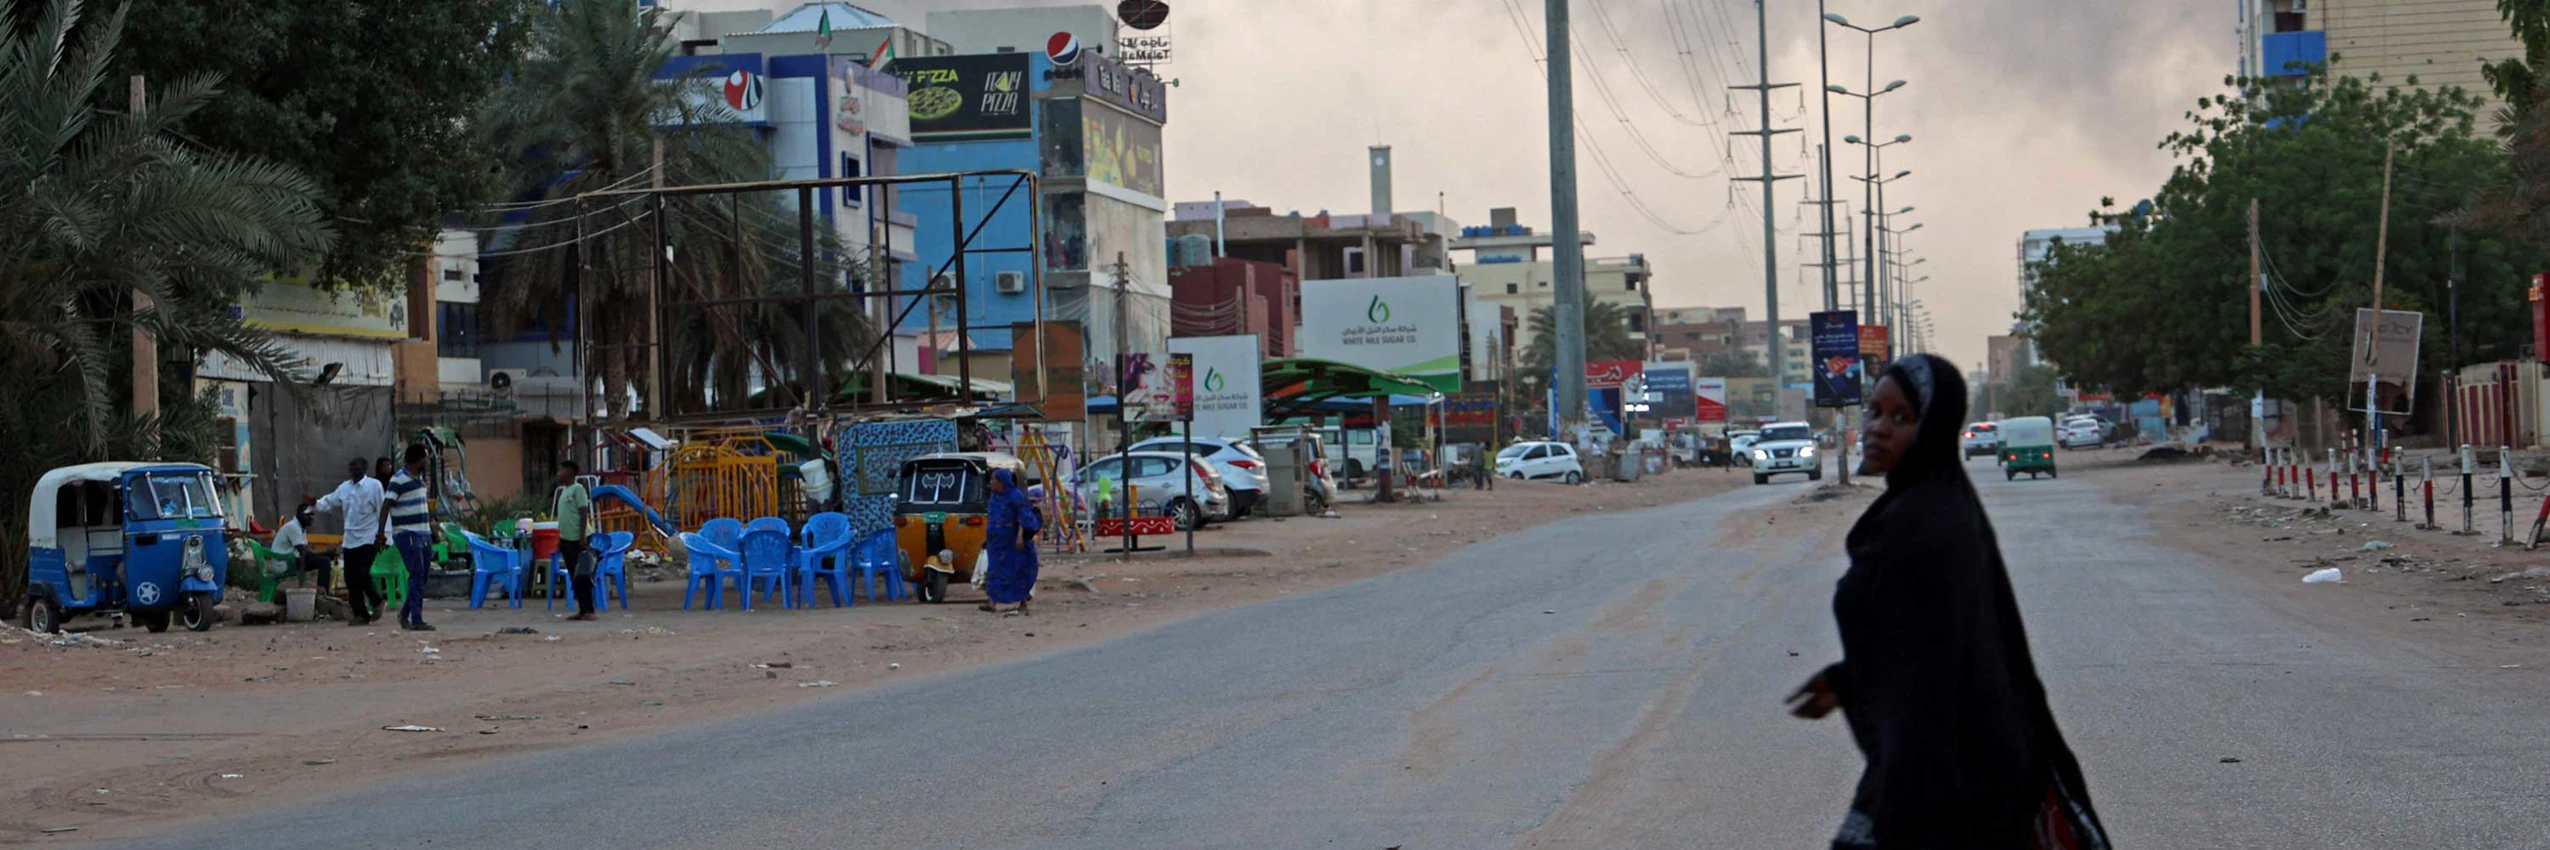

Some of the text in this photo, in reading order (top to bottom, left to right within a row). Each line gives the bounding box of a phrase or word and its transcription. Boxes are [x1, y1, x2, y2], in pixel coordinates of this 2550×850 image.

[916, 68, 959, 83] PZZA
[981, 92, 1018, 115] PIZZA
[1342, 336, 1363, 345] WHITE
[1366, 336, 1380, 345] NILE
[1382, 335, 1404, 344] SUGAR
